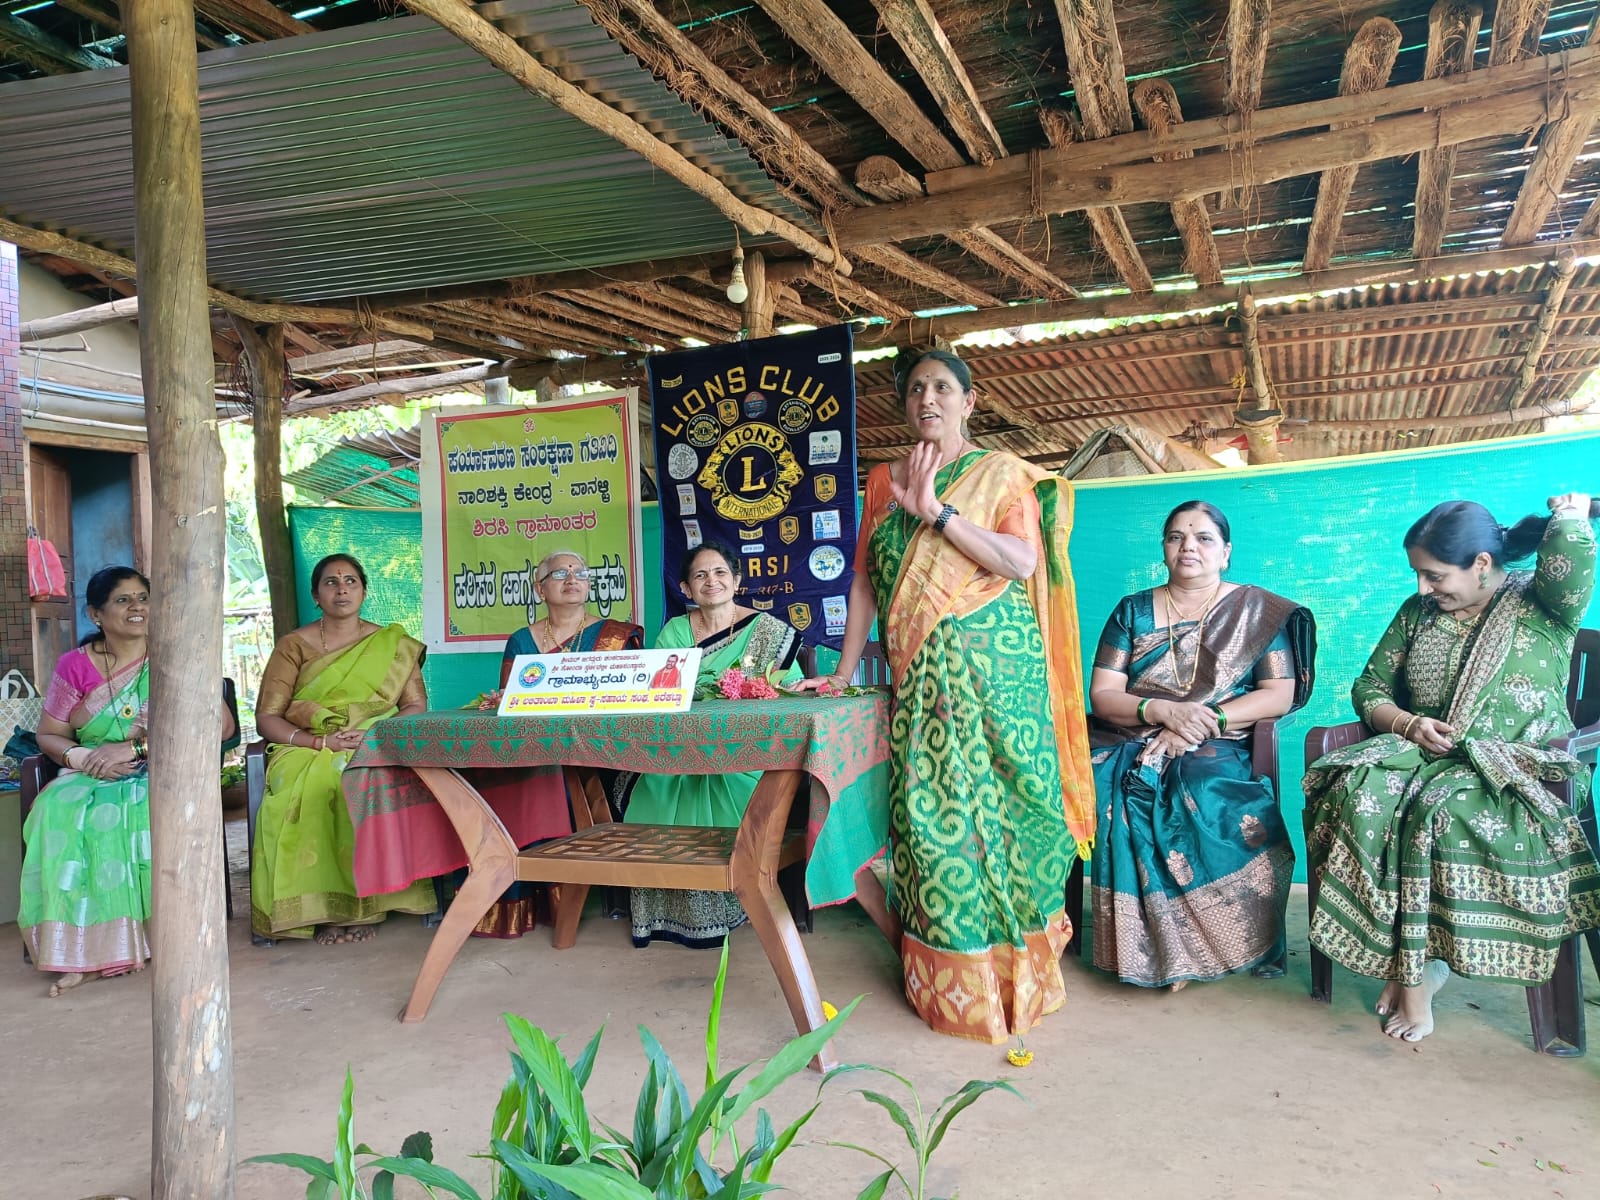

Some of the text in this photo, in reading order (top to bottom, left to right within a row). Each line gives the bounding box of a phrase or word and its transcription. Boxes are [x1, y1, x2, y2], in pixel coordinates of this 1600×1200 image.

[661, 365, 840, 437] LIONS CLUB
[724, 427, 781, 450] LIONS
[521, 438, 574, 476] ಸಂರಕ್ಷಣಾ
[580, 433, 617, 464] ಗತಿವಿಧಿ
[740, 456, 767, 492] L
[458, 486, 508, 508] ನಾರಿಶಕ್ತಿ
[514, 482, 552, 504] ಕೇಂದ್ರ
[722, 498, 779, 517] INTERNATIONAL
[473, 510, 597, 540] ಶಿರಸಿ ಗ್ರಾಮಾಂತರ
[738, 555, 789, 577] RSI
[454, 561, 496, 608] ಪರಿಸರ
[501, 559, 543, 625] ಜಾಗೃ
[548, 673, 627, 690] ಗ್ರಾಮಾಭ್ಯುದಯ
